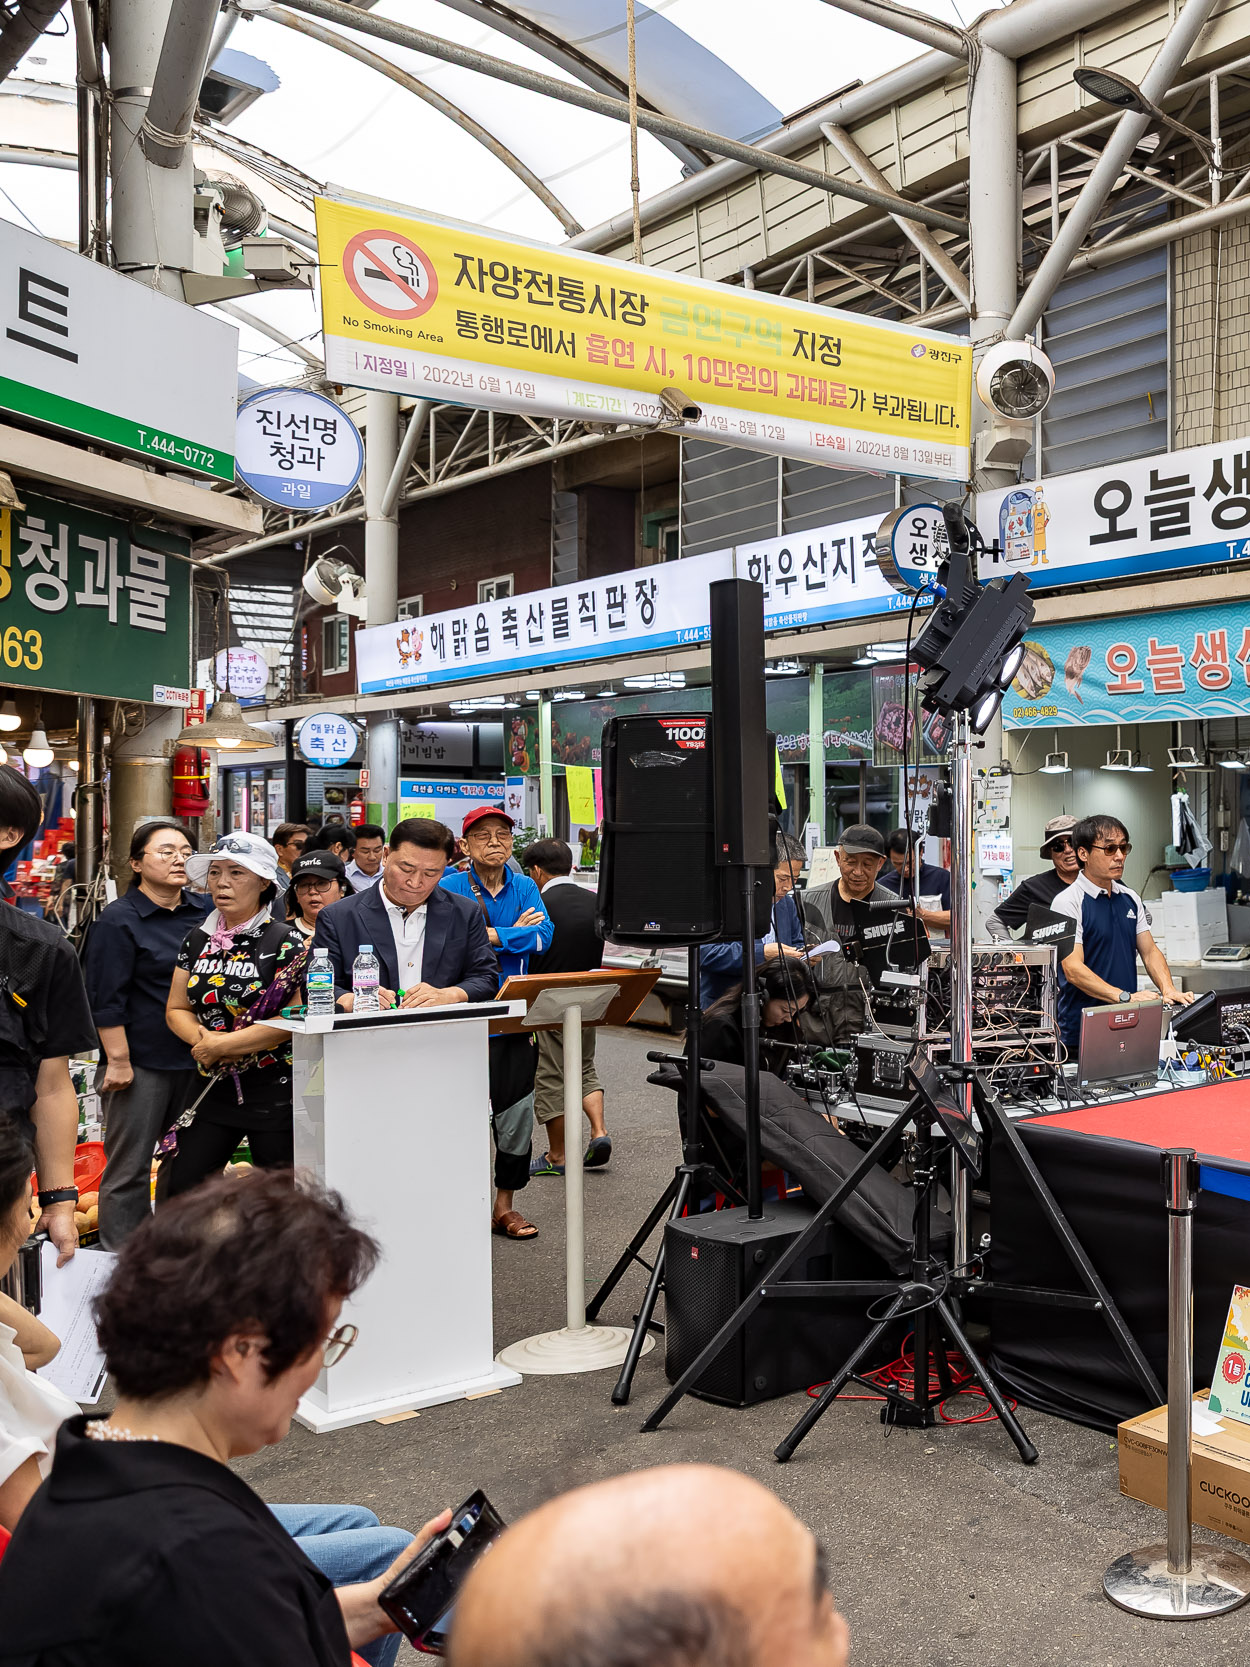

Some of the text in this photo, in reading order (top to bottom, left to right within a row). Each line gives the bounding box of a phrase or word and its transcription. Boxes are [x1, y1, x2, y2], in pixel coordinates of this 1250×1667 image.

[6, 266, 79, 364] 트
[453, 252, 842, 367] 자양전통시장 금연구역 지정
[343, 315, 444, 344] No Smoking Area
[455, 309, 960, 429] 통행로에서 흡연 시, 10만원의 과태료가 부과됩니다.
[928, 348, 962, 365] 광진구
[363, 354, 536, 399] 지정일 2022년 6월 14일
[255, 409, 338, 446] 진선명
[761, 426, 785, 441] 12일
[137, 429, 215, 469] T.444-0772
[269, 442, 325, 472] 청과
[815, 433, 952, 468] 단속일 2022년 8월 13일부터
[281, 482, 312, 499] 과일
[17, 515, 171, 633] 청과물
[429, 577, 657, 660] 해맑음 축산물직판장
[1013, 705, 1058, 719] 02)466-4829
[310, 723, 347, 735] 해맑음
[310, 737, 348, 752] 축산
[1032, 920, 1067, 940] SHURE
[1114, 1012, 1135, 1023] ELF
[1227, 1359, 1241, 1377] 1등
[1199, 1480, 1250, 1509] CUCKOO
